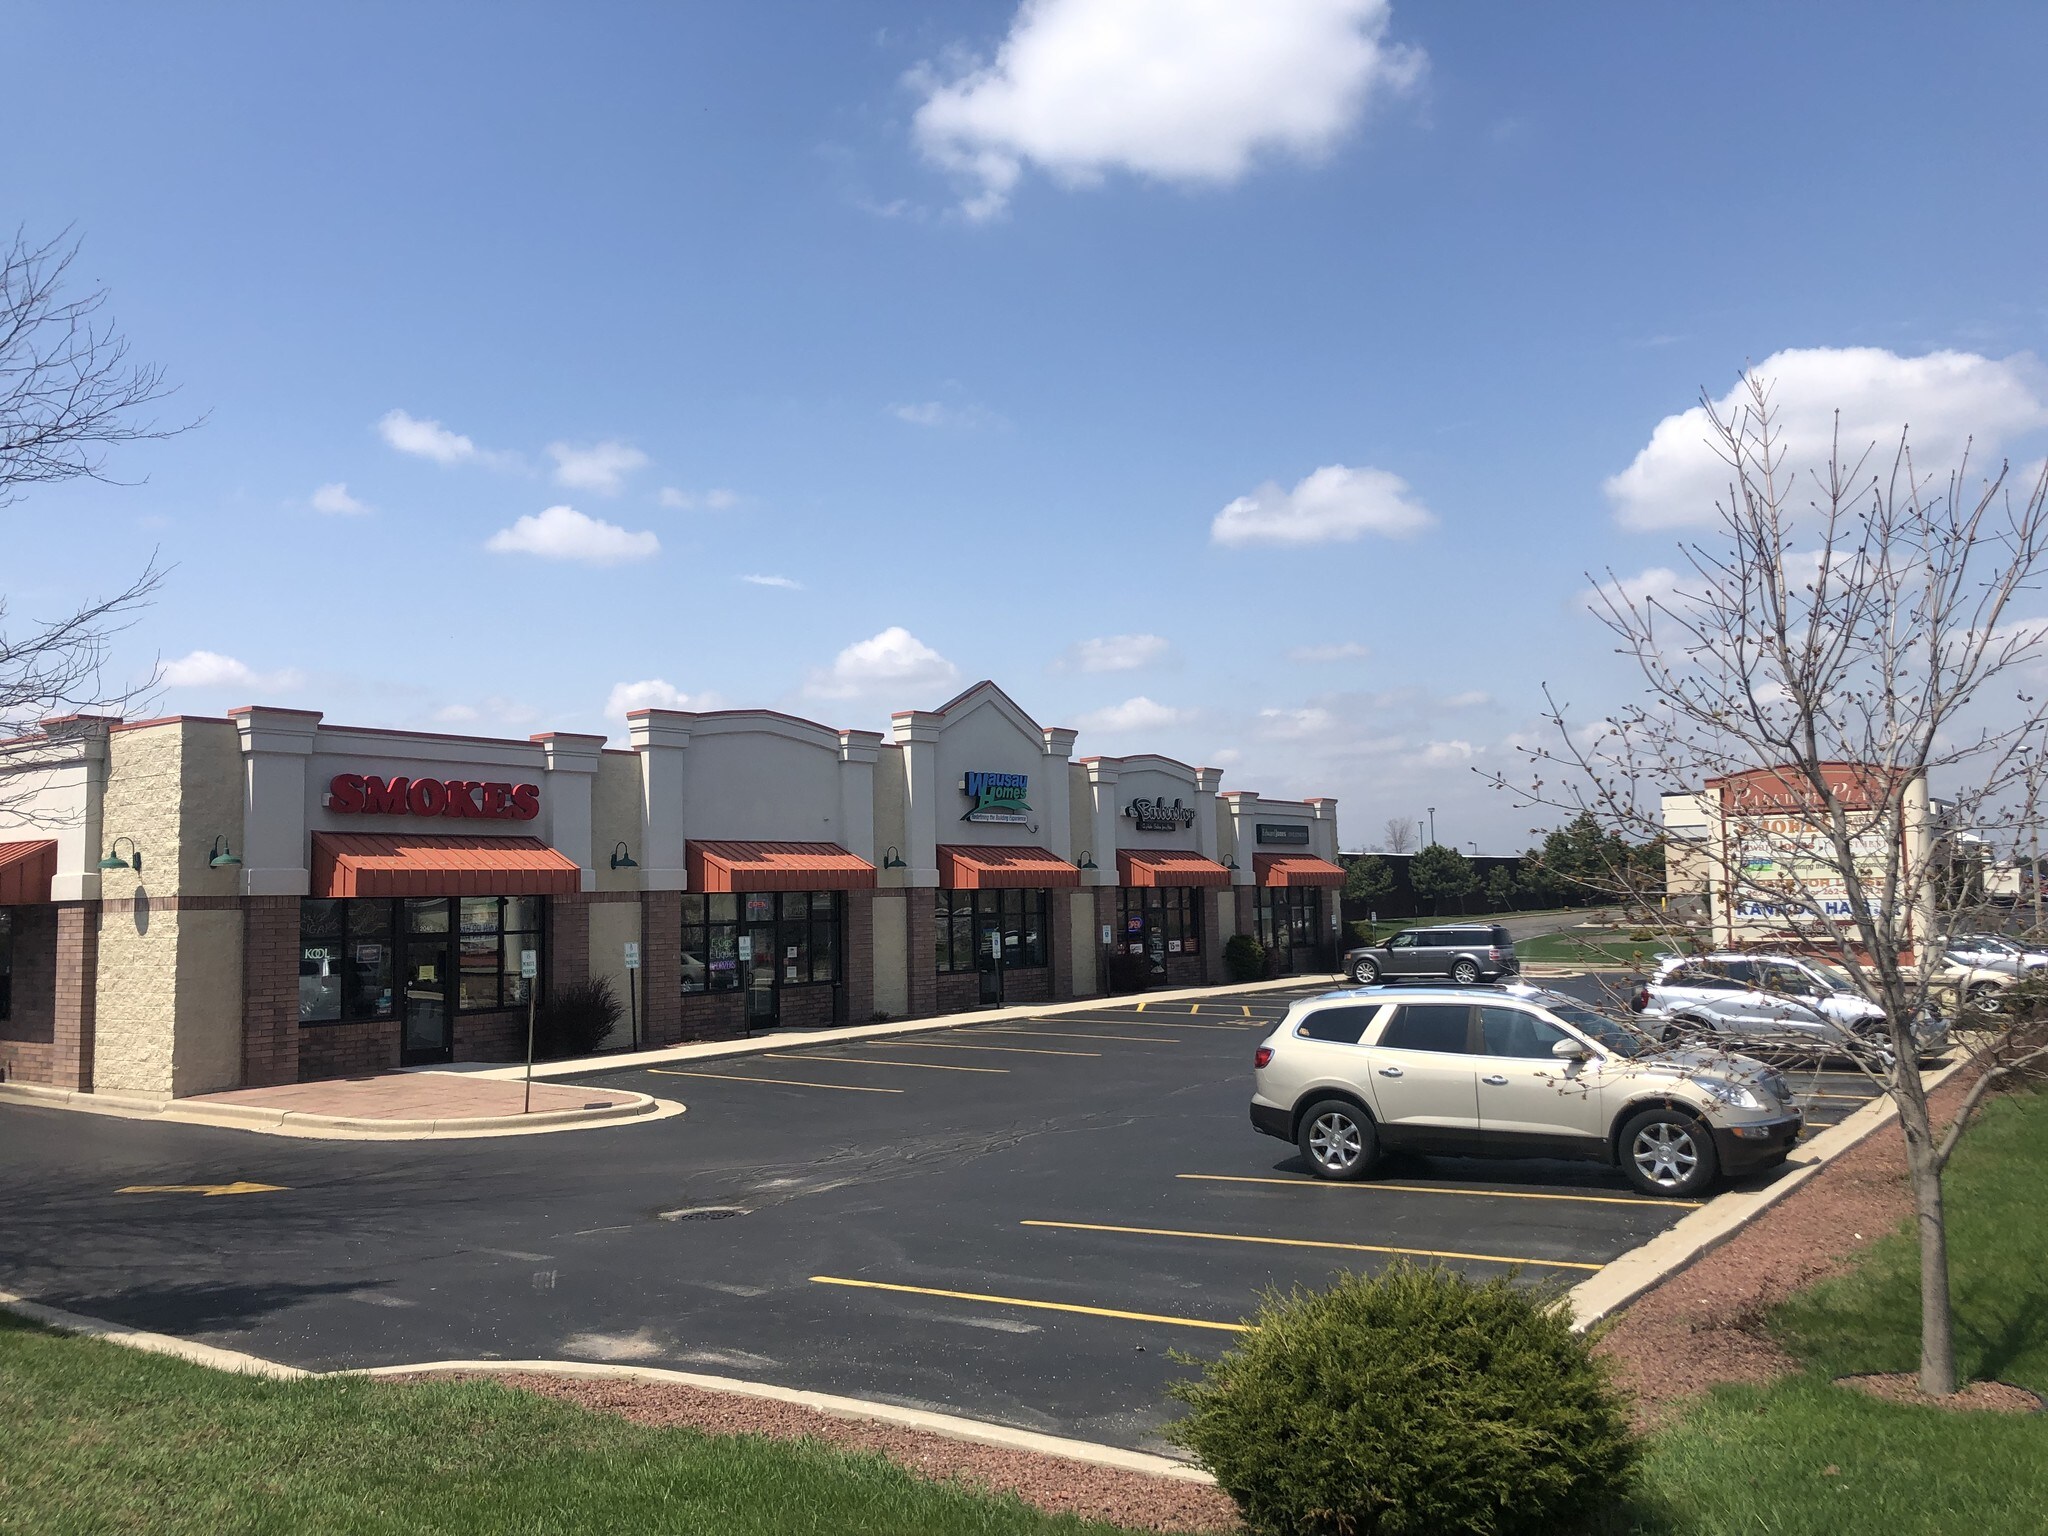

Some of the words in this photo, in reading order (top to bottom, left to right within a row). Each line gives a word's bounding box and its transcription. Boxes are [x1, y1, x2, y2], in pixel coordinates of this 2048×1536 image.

[966, 770, 1028, 797] Wausau
[979, 785, 1027, 806] Homes
[330, 773, 539, 821] SMOKES
[1133, 797, 1195, 828] Barbershop
[747, 901, 766, 909] OPEN
[304, 948, 331, 960] KOOL
